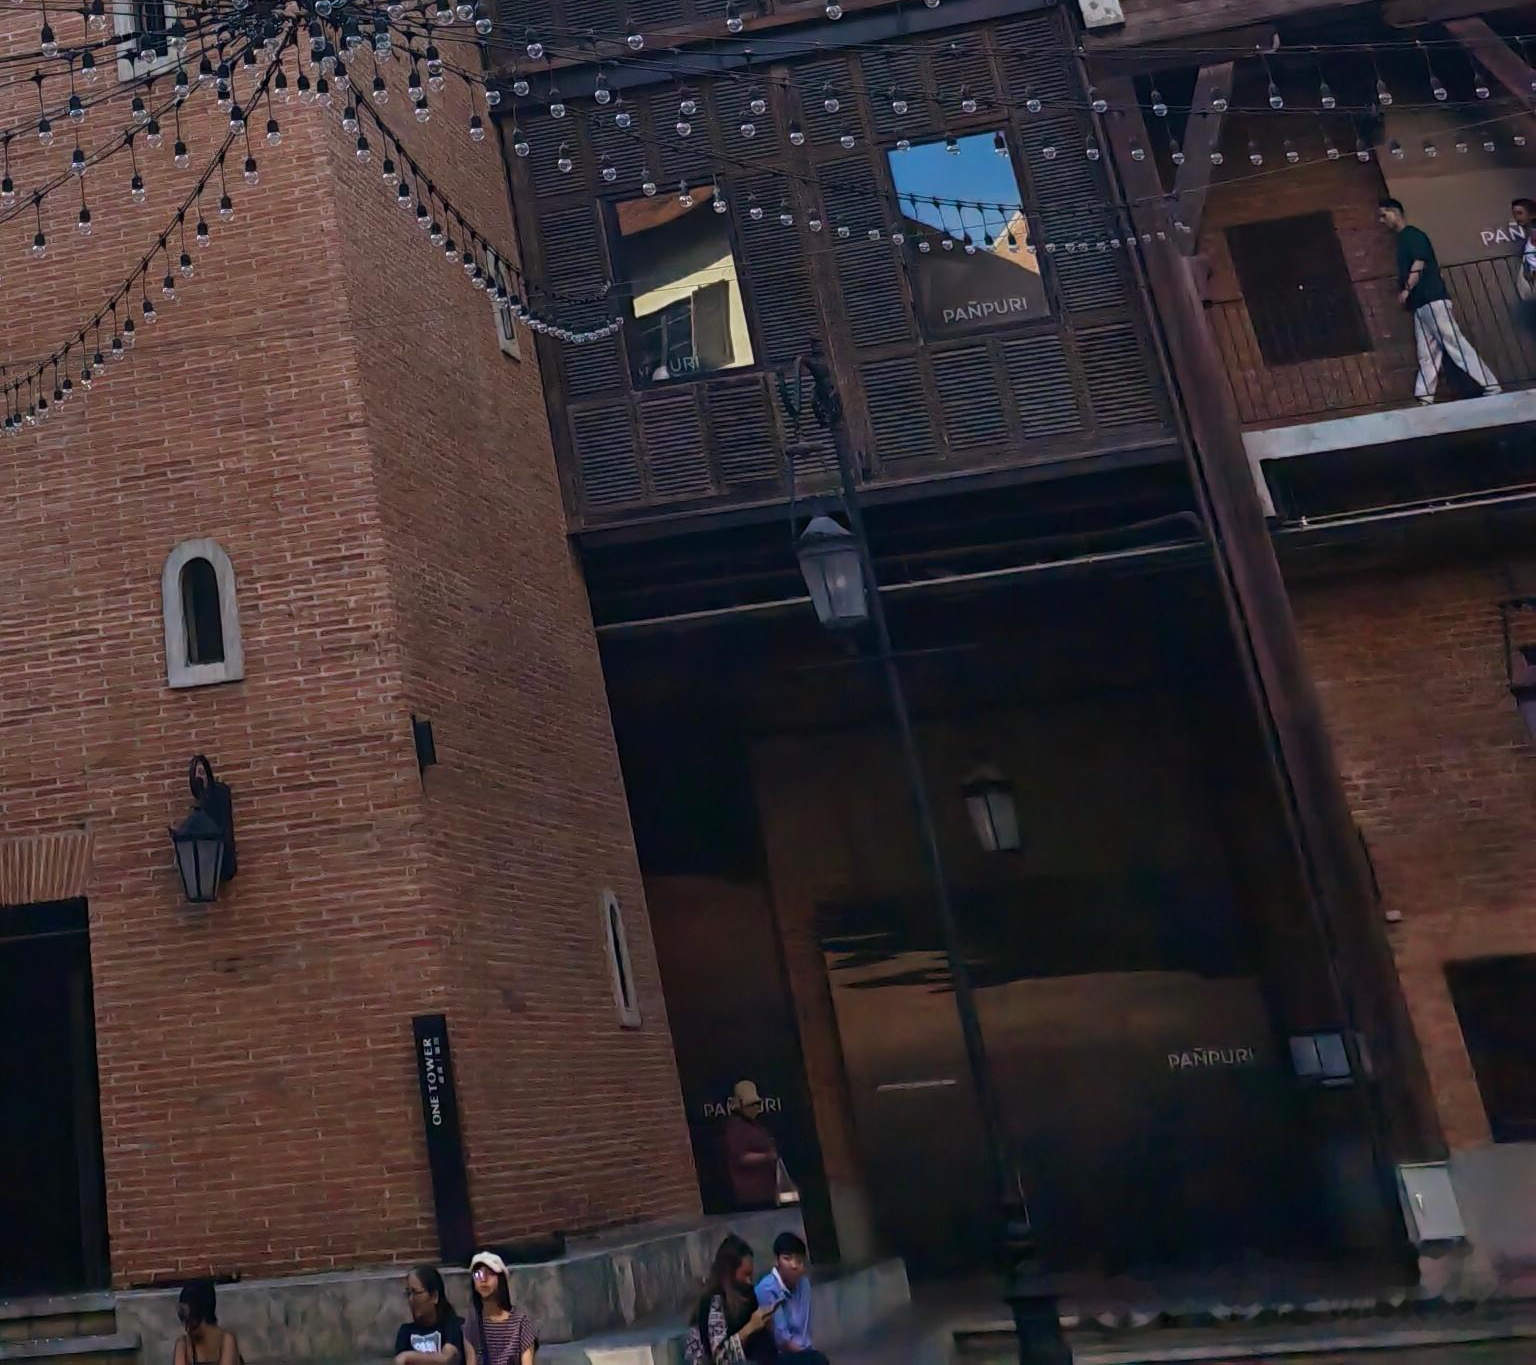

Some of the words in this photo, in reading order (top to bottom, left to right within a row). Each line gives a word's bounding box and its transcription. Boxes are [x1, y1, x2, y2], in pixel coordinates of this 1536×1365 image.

[1479, 221, 1526, 246] PAÑ
[942, 296, 1028, 324] PAÑPURI
[422, 1038, 438, 1093] TOWER
[429, 1096, 442, 1126] ONE
